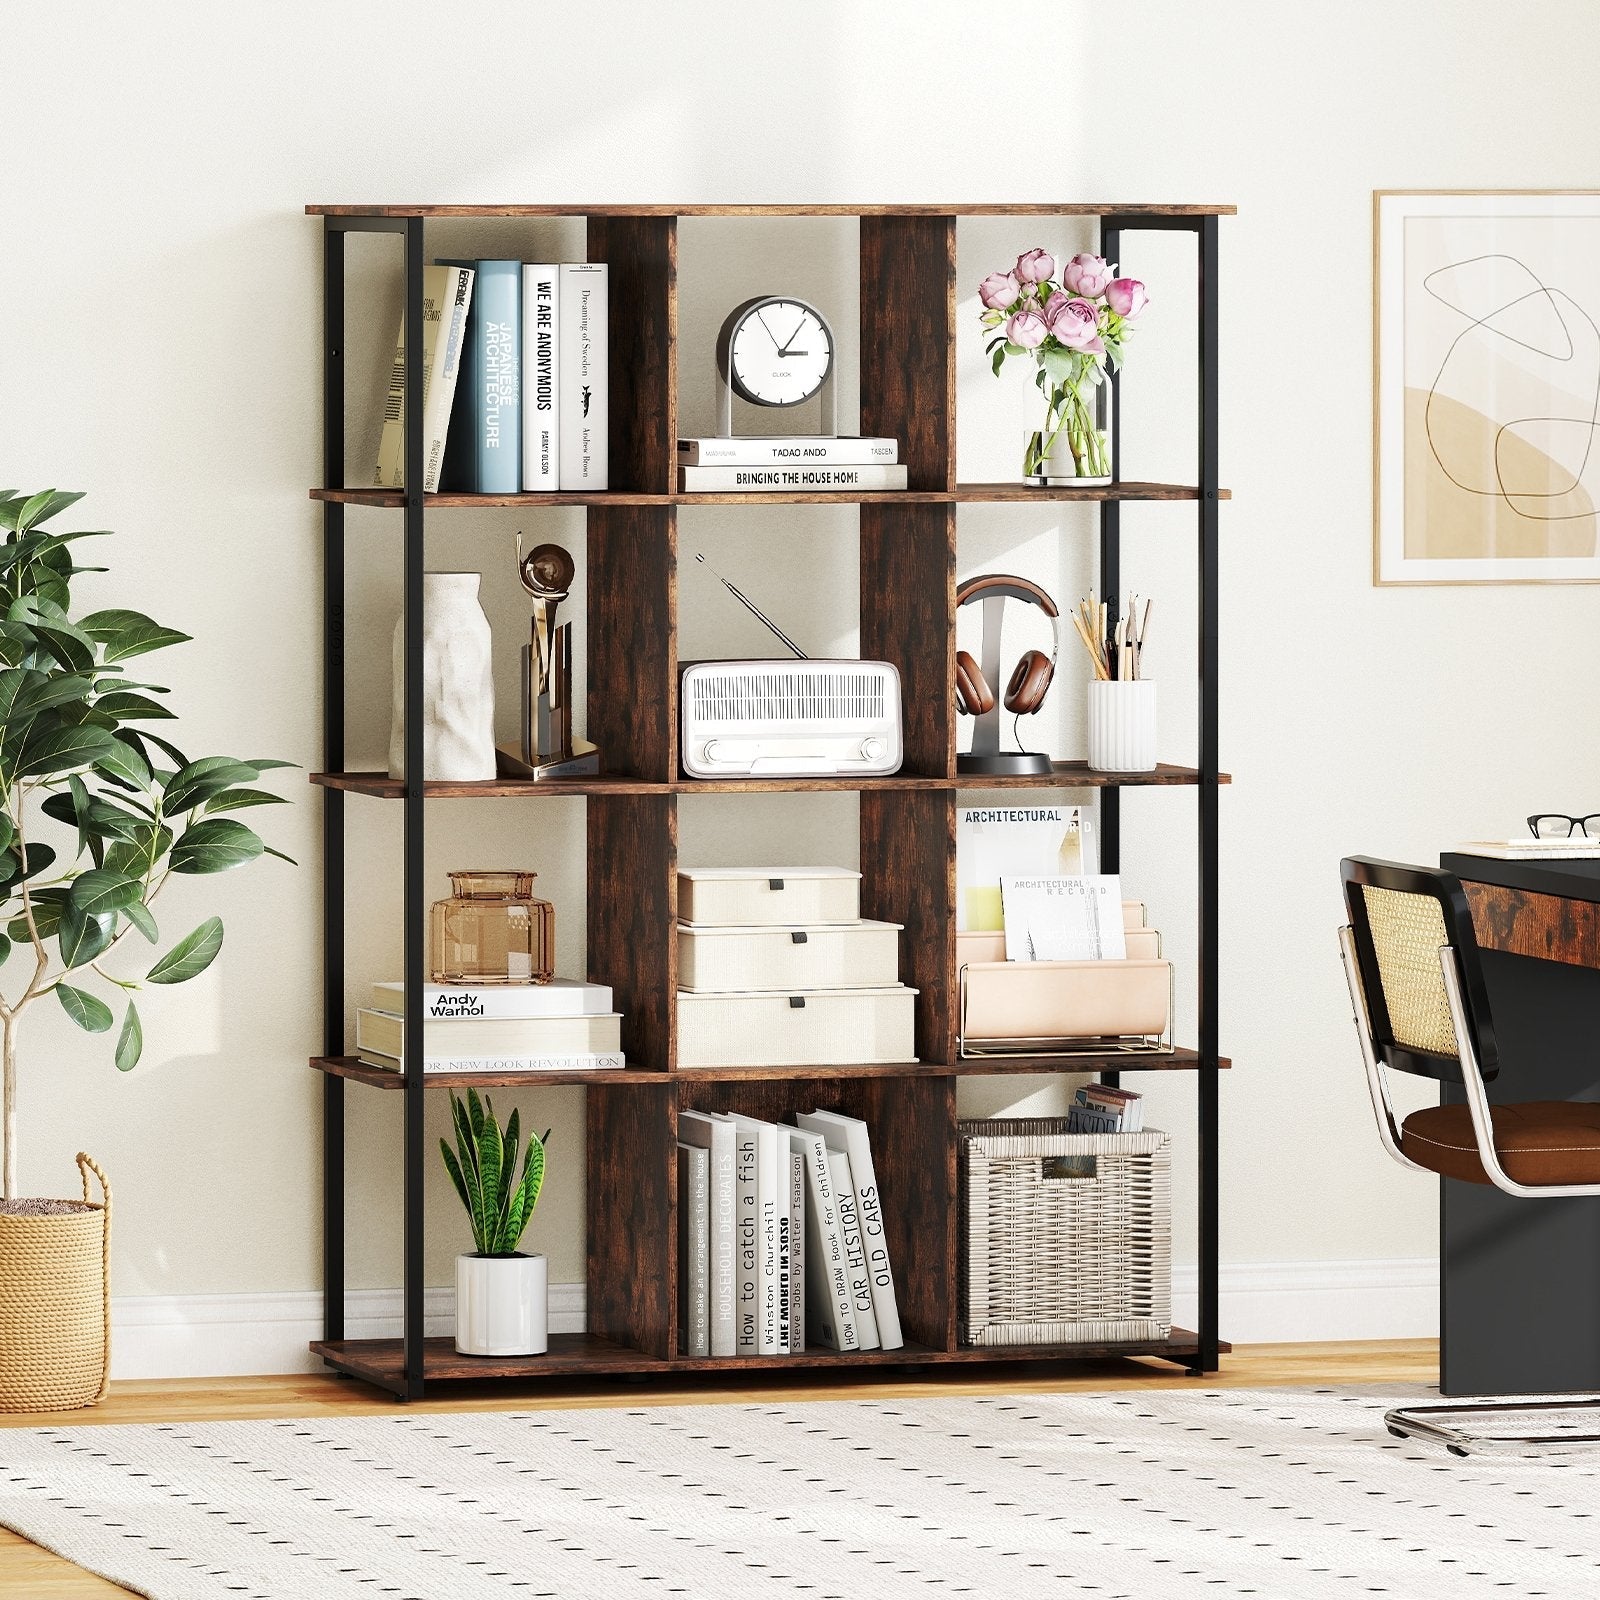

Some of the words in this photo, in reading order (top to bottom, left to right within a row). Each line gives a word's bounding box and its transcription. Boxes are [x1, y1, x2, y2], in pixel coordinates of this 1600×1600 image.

[455, 270, 470, 307] FRANK
[537, 281, 552, 301] WE
[537, 304, 552, 329] ARE
[580, 290, 591, 332] Dreaming
[581, 333, 591, 343] of
[499, 322, 512, 406] JAPANESE
[537, 332, 552, 411] ANONYMOUS
[581, 344, 591, 377] Sweden
[486, 321, 500, 449] ARCHITECTURE
[541, 430, 549, 453] PARMY
[582, 428, 591, 453] Andrew
[772, 448, 801, 457] TADAO
[803, 448, 827, 457] ANDO
[541, 454, 549, 475] OLSON
[582, 456, 591, 478] Brown
[736, 472, 780, 484] BRINGING
[782, 472, 799, 484] THE
[802, 472, 831, 484] HOUSE
[833, 472, 858, 484] HOME
[965, 810, 1062, 823] ARCHITECTURAL
[1014, 880, 1084, 889] ARCHITECTURAL
[430, 1005, 484, 1017] Warhol
[437, 993, 478, 1007] Andy
[449, 1061, 480, 1070] NEW
[486, 1059, 524, 1069] LOOK
[528, 1057, 620, 1069] REVOLUTION
[696, 1153, 704, 1179] house
[739, 1142, 754, 1183] fish
[815, 1142, 830, 1198] children
[696, 1183, 704, 1198] the
[719, 1154, 732, 1233] DECORATES
[793, 1156, 801, 1209] Isaacson
[696, 1203, 704, 1214] in
[743, 1196, 754, 1205] a
[861, 1186, 882, 1236] CARS
[825, 1206, 834, 1226] for
[739, 1217, 754, 1270] catch
[764, 1202, 774, 1276] Churchill
[793, 1217, 801, 1257] Walter
[837, 1193, 864, 1269] HISTORY
[697, 1220, 705, 1273] arrangement
[828, 1233, 840, 1261] Book
[793, 1263, 802, 1276] by
[871, 1249, 890, 1286] OLD
[697, 1278, 704, 1288] an
[719, 1241, 731, 1320] HOUSEHOLD
[741, 1282, 754, 1302] to
[834, 1268, 846, 1296] DRAW
[696, 1293, 704, 1314] make
[793, 1282, 801, 1308] Jobs
[853, 1278, 870, 1311] CAR
[764, 1285, 774, 1345] Winston
[839, 1302, 849, 1318] TO
[696, 1318, 704, 1328] to
[740, 1313, 754, 1346] How
[793, 1315, 801, 1348] Steve
[843, 1323, 855, 1345] HOW
[696, 1333, 704, 1349] How
